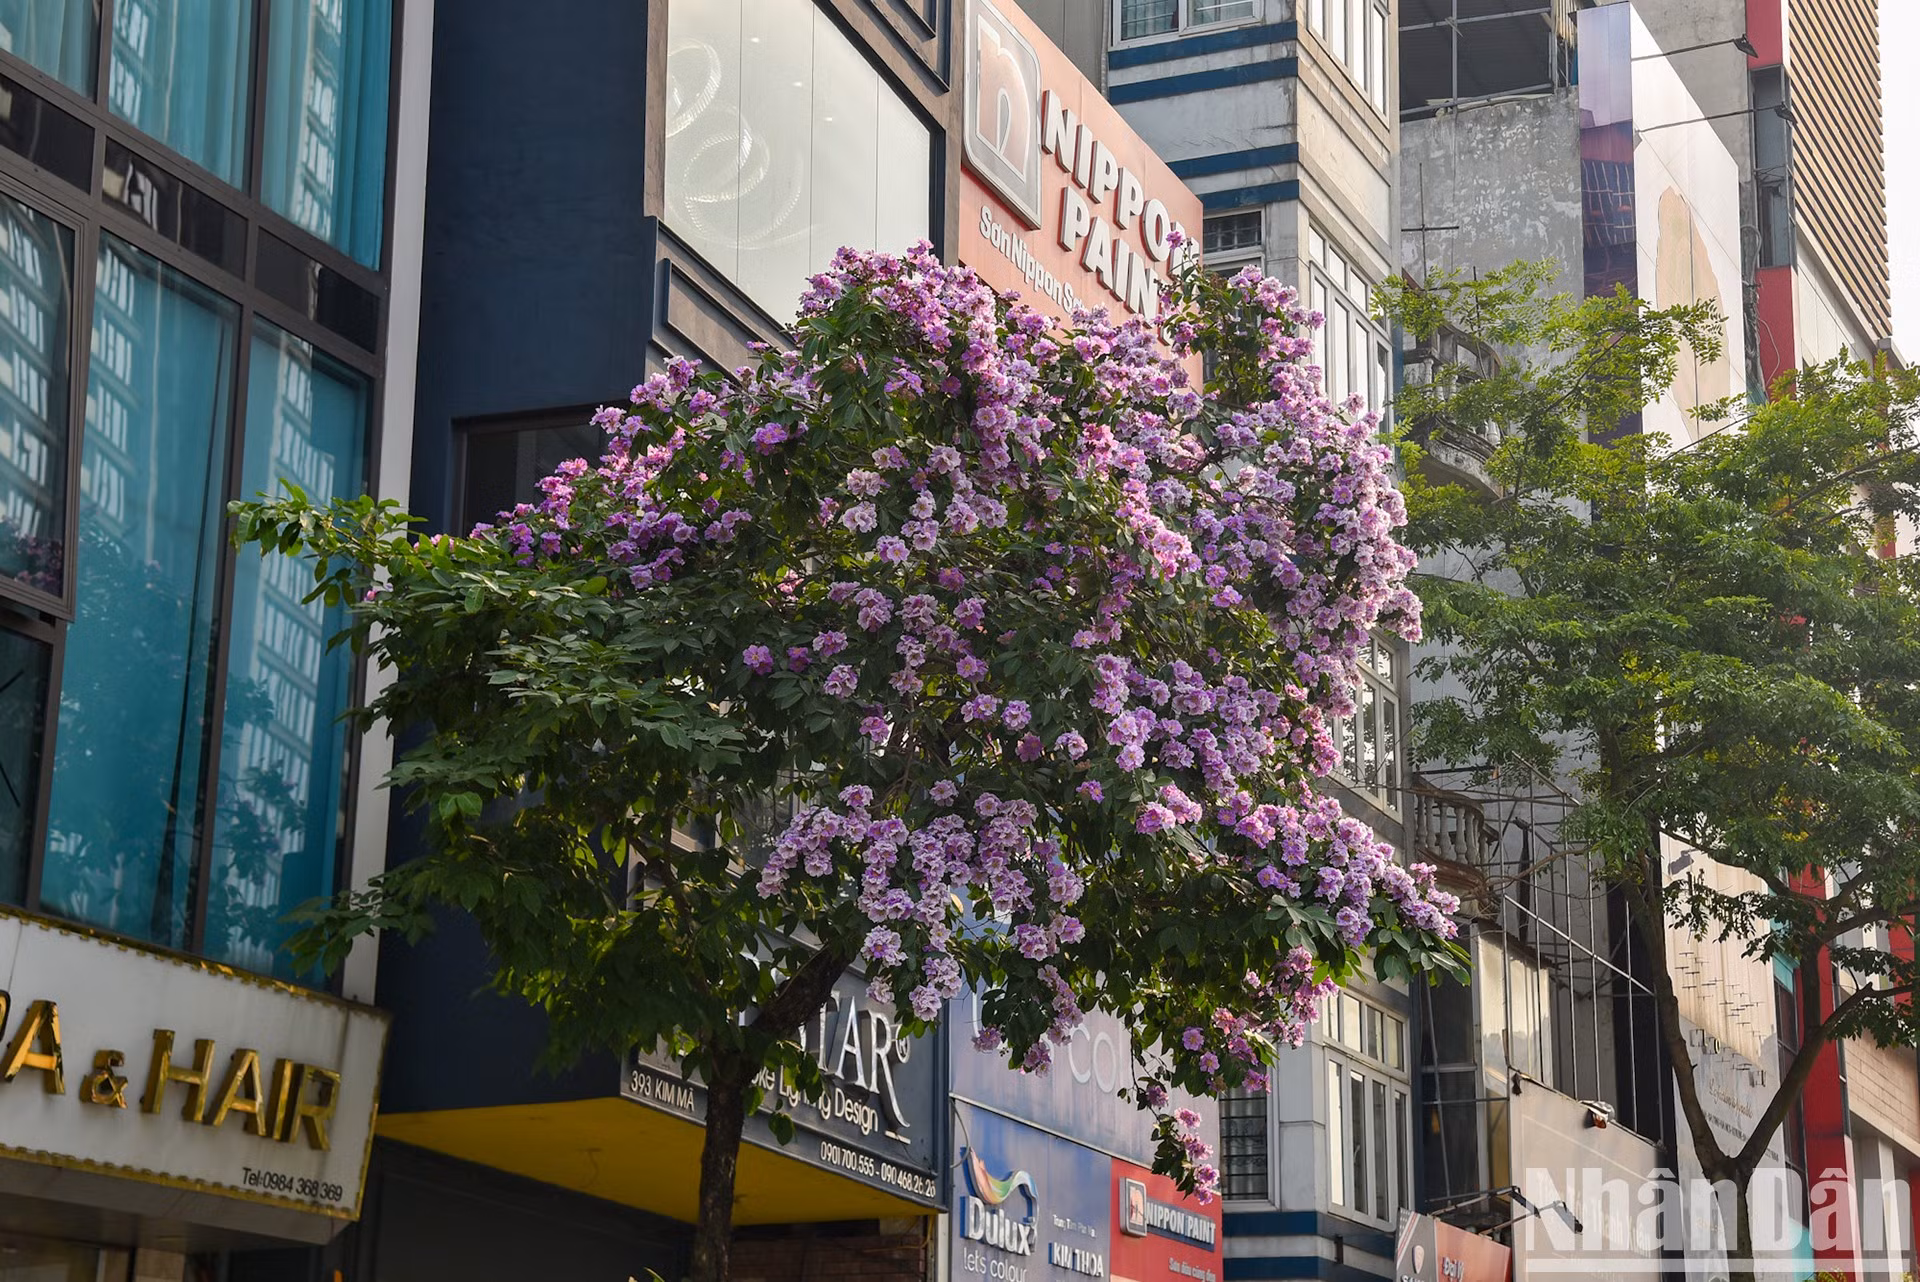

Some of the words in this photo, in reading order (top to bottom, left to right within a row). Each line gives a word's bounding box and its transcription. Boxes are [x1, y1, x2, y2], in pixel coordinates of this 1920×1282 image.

[1011, 232, 1061, 306] Nippon
[1059, 186, 1172, 340] PAIN
[80, 1049, 128, 1109] &
[142, 1028, 341, 1151] HAIR
[630, 1070, 651, 1096] 393
[655, 1079, 675, 1105] KIM
[834, 1088, 878, 1136] Design
[967, 1195, 1031, 1257] Dulux
[1146, 1201, 1184, 1235] NIPPON
[1186, 1214, 1216, 1245] PAINT
[1074, 1248, 1105, 1278] THOA
